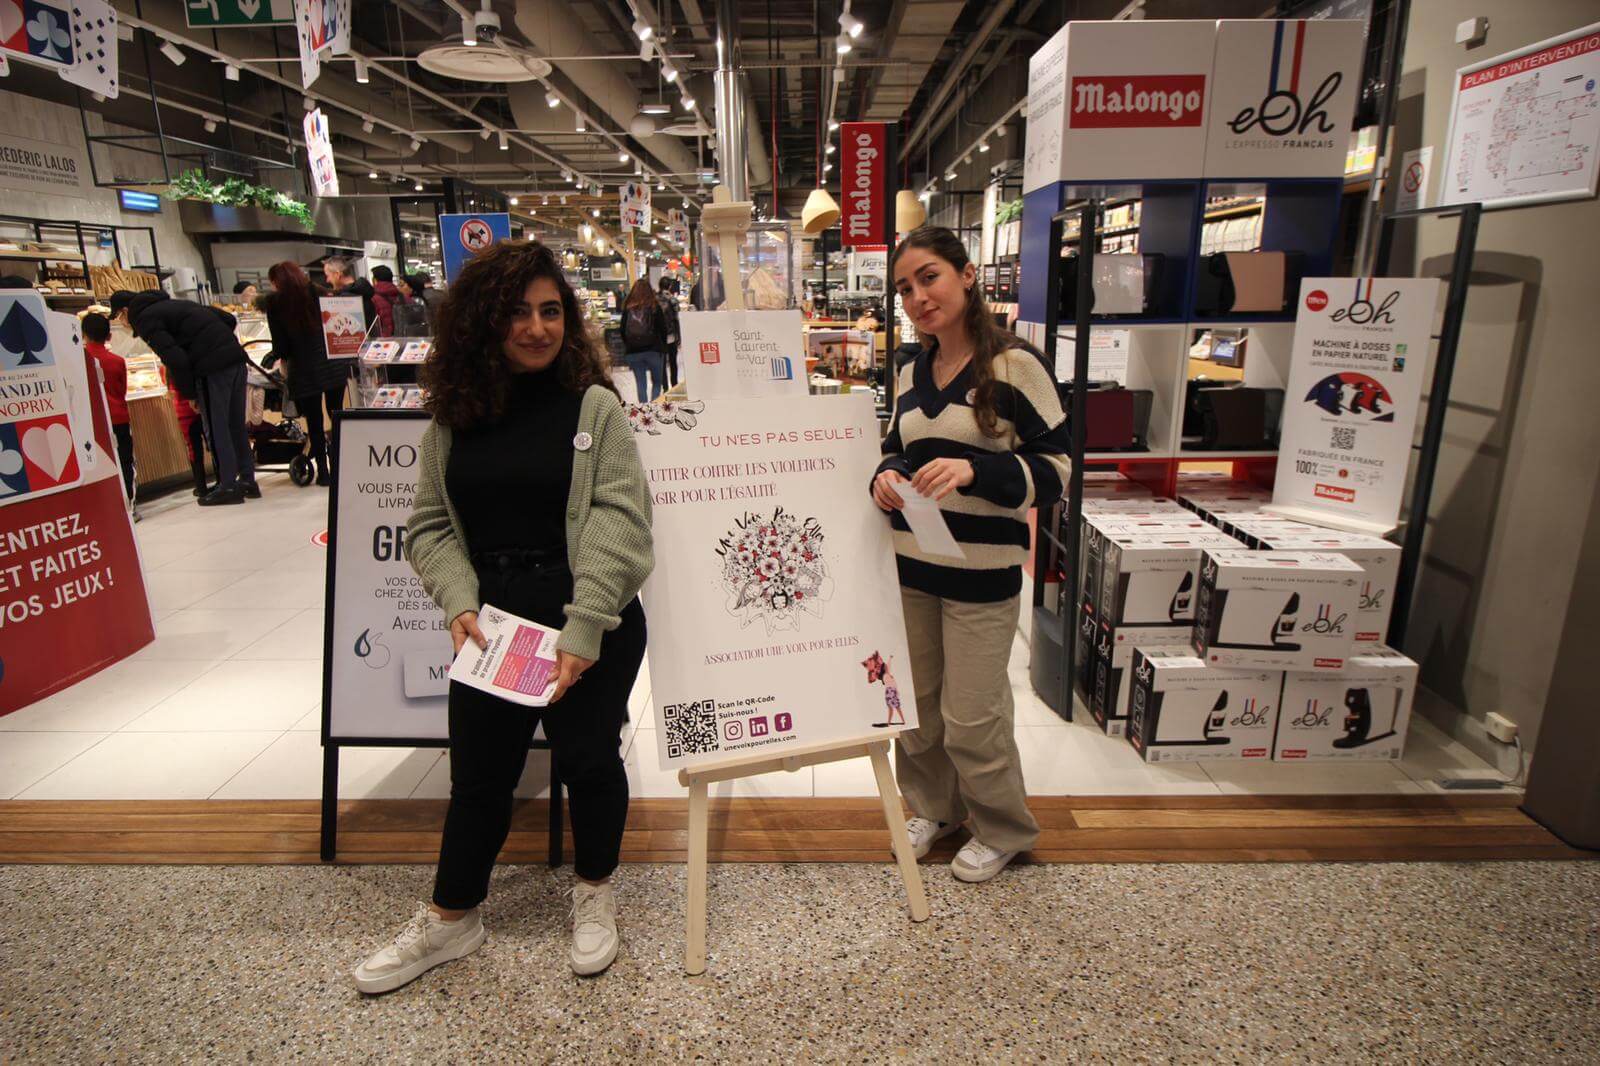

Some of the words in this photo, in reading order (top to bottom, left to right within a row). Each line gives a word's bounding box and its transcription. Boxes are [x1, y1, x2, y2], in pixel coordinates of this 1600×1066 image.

[1465, 71, 1495, 87] PLAN
[1074, 82, 1200, 121] Malongo
[1282, 140, 1334, 149] FRANÇAIS
[44, 154, 76, 173] LALOS
[849, 133, 878, 237] Malongo
[733, 330, 765, 341] Saint-
[734, 341, 780, 353] Laurent-
[1313, 339, 1351, 349] MACHINE
[1362, 342, 1391, 351] DOSES
[748, 353, 767, 365] Var
[1324, 350, 1350, 359] PAPIER
[1352, 352, 1388, 361] NATUREL
[34, 380, 56, 397] JEU
[700, 436, 721, 448] TU
[766, 431, 799, 444] PAS
[805, 428, 856, 442] SEULE
[693, 463, 741, 479] CONTRE
[745, 462, 768, 476] LES
[771, 457, 835, 474] VIOLENCES
[1296, 460, 1319, 475] 100%
[1353, 457, 1384, 467] FRANCE
[358, 483, 393, 494] VOUS
[681, 488, 717, 503] POUR
[734, 511, 761, 530] Voix
[774, 505, 796, 522] Pour
[0, 513, 89, 557] ENTREZ,
[30, 540, 102, 582] FAITES
[385, 577, 407, 586] VOS
[50, 571, 104, 609] JEUX
[375, 589, 403, 598] CHEZ
[704, 648, 764, 665] ASSOCIATION
[766, 646, 785, 657] UNE
[786, 642, 808, 654] VOIX
[809, 639, 833, 651] POUR
[835, 636, 860, 648] ELLES
[717, 702, 735, 710] Scan
[745, 695, 776, 706] QR-Code
[719, 709, 754, 720] Suis-nous
[723, 734, 797, 751] unevoixpourelles.com
